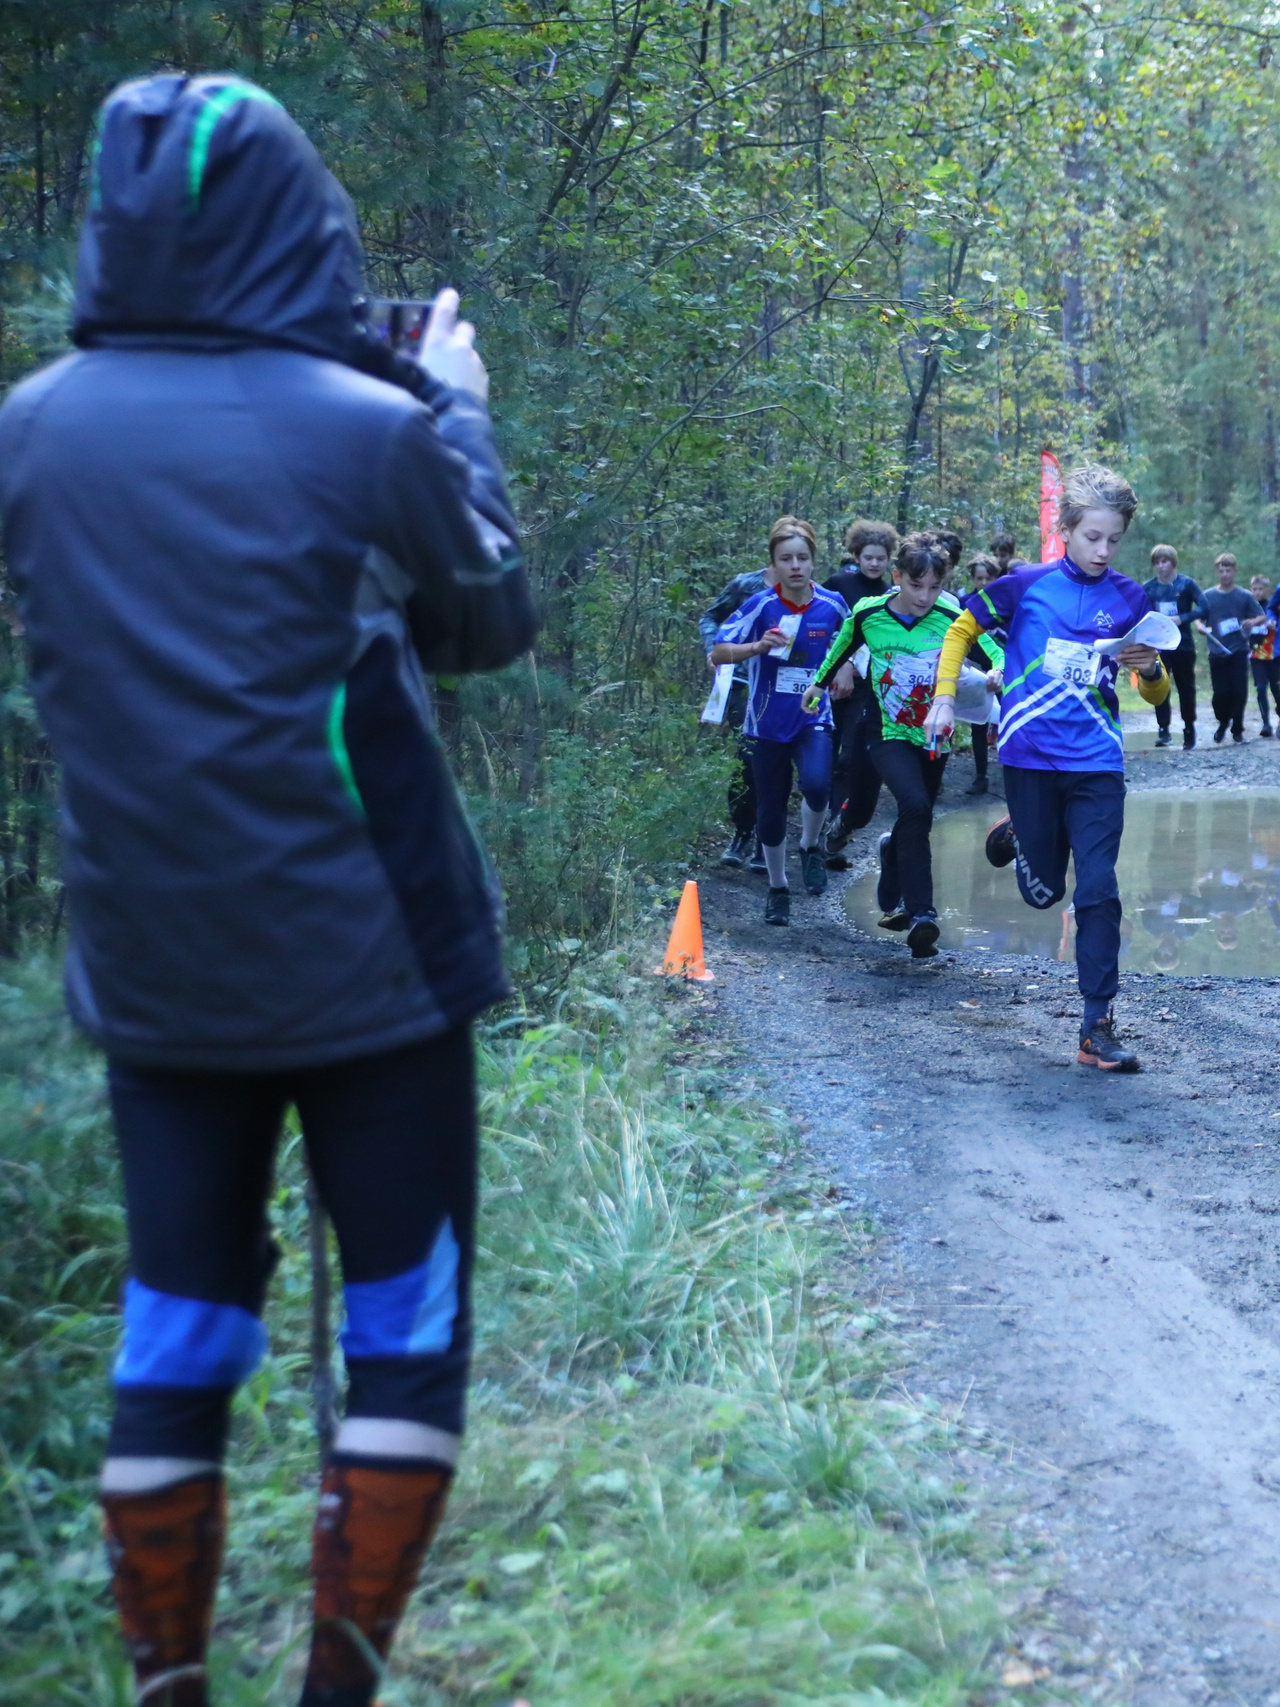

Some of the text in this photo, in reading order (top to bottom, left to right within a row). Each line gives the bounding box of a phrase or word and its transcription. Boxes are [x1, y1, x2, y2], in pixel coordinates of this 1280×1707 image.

[885, 651, 892, 660] N
[908, 674, 932, 687] 304
[1063, 666, 1092, 683] 303
[792, 683, 811, 693] 30
[1012, 834, 1054, 905] NING
